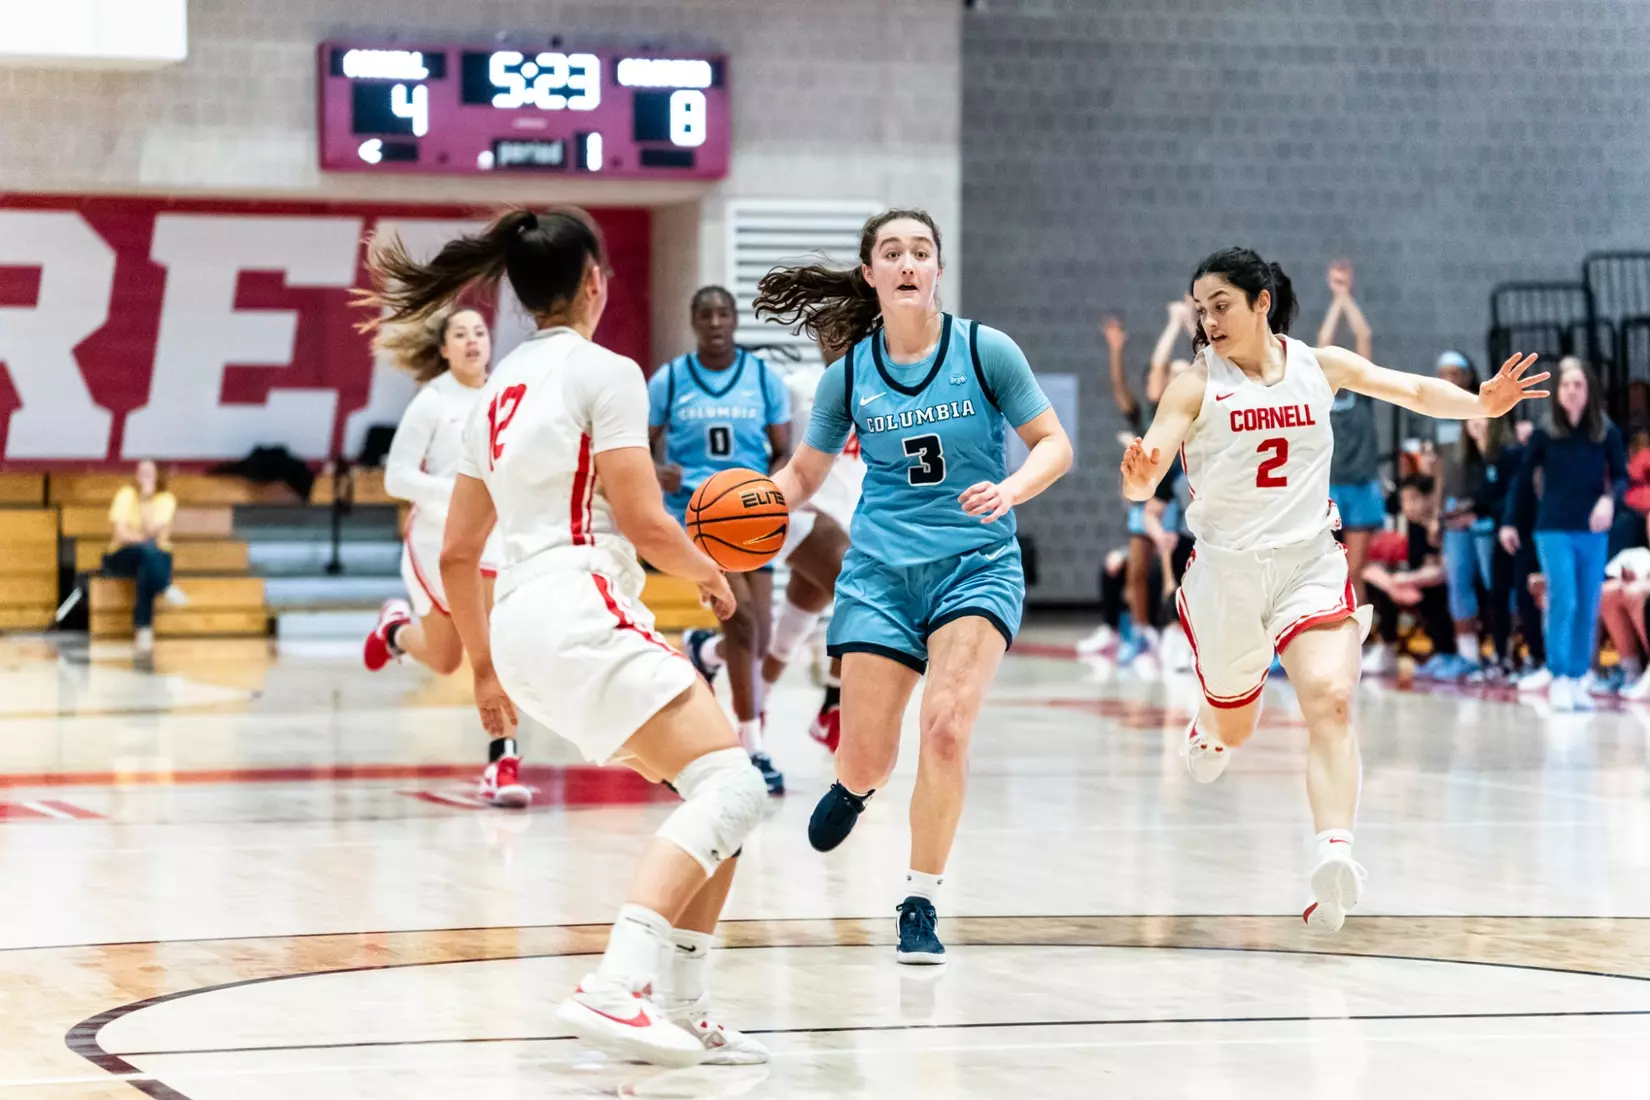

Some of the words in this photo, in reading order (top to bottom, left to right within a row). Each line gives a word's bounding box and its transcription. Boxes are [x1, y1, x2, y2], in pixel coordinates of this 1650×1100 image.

[490, 51, 600, 111] 5:23
[391, 84, 429, 136] 4
[670, 90, 706, 147] 8
[487, 384, 527, 471] 12
[866, 399, 976, 433] COLUMBIA
[1230, 404, 1315, 432] CORNELL
[705, 424, 734, 460] 0
[901, 433, 946, 487] 3
[1256, 437, 1289, 488] 2
[741, 491, 786, 508] ELITE
